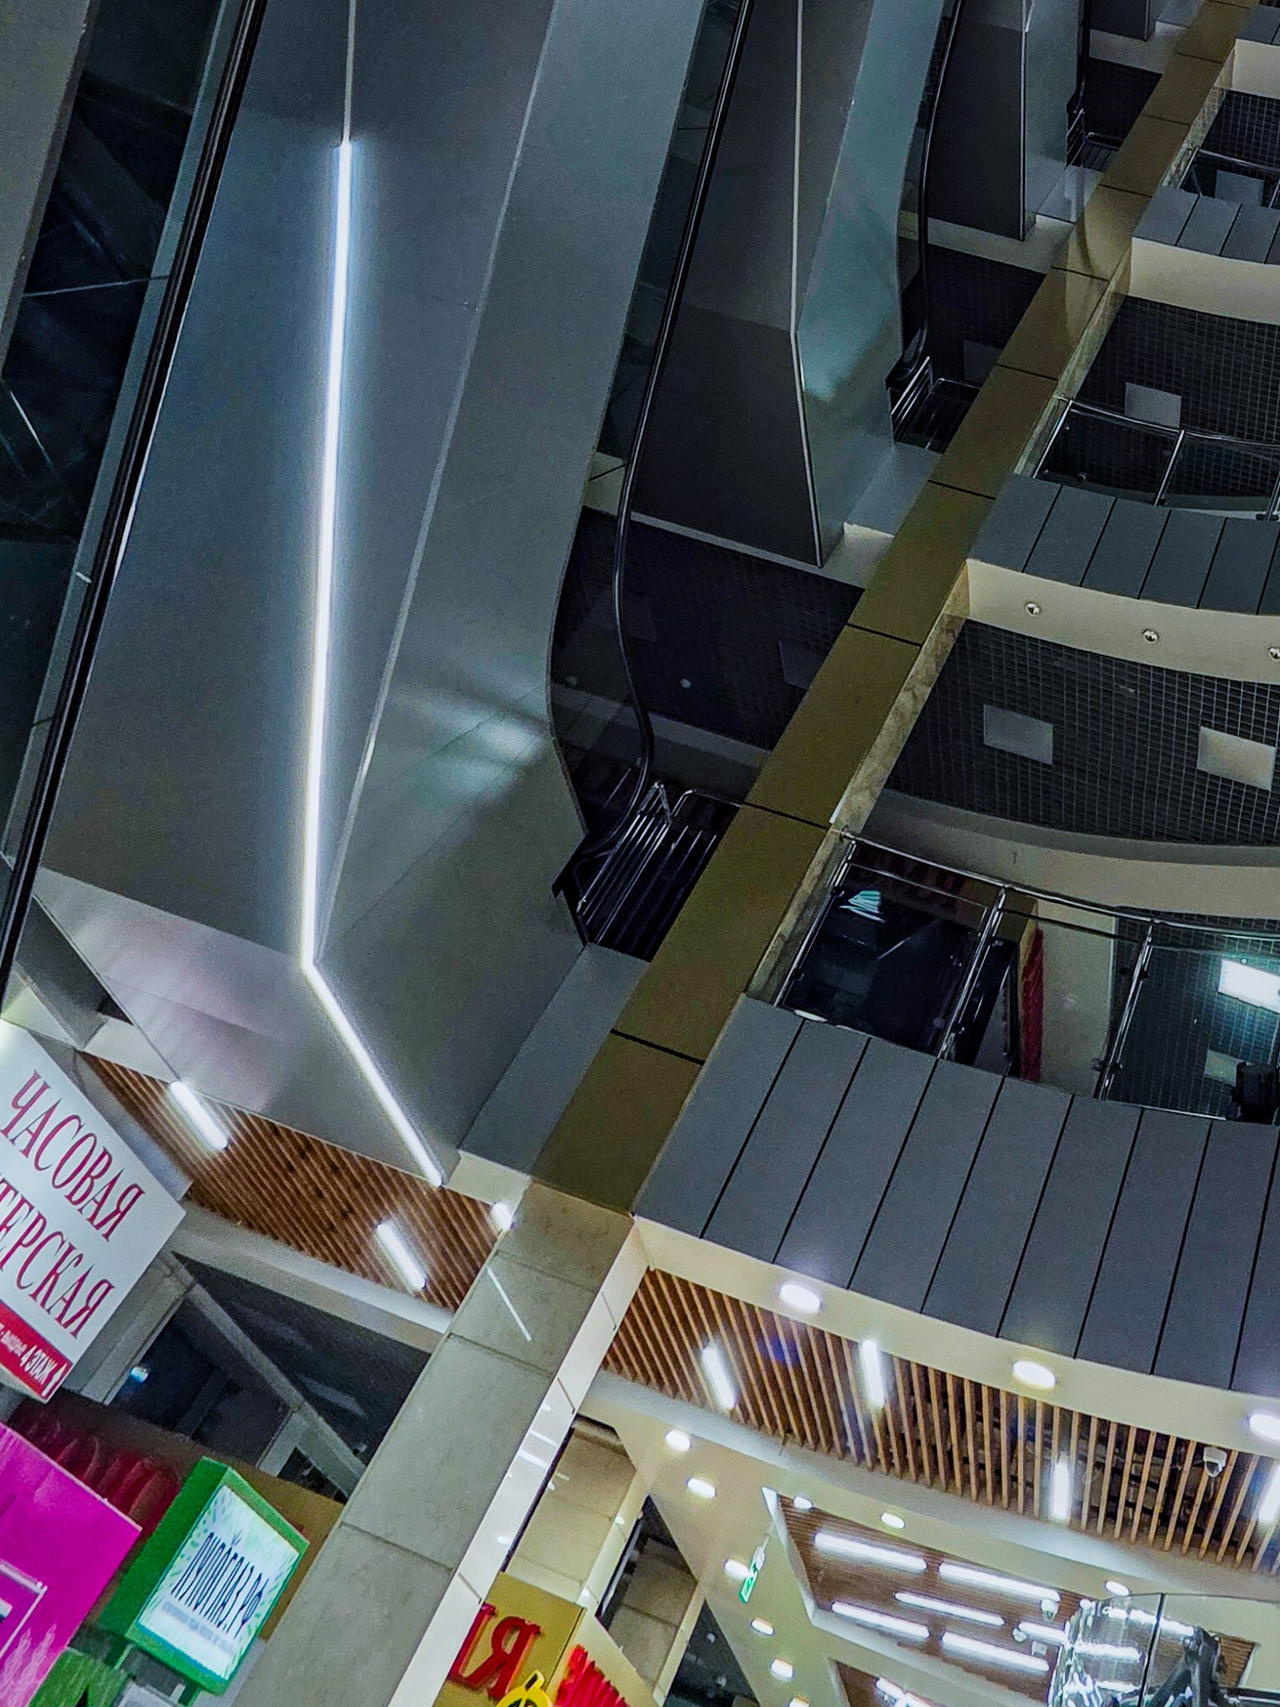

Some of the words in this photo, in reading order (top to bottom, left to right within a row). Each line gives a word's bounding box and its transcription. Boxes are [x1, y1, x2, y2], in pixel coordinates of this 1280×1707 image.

[0, 1069, 146, 1243] ЧАСОВАЯ
[20, 1344, 38, 1367] 4
[24, 1349, 58, 1385] ЭТАЖ
